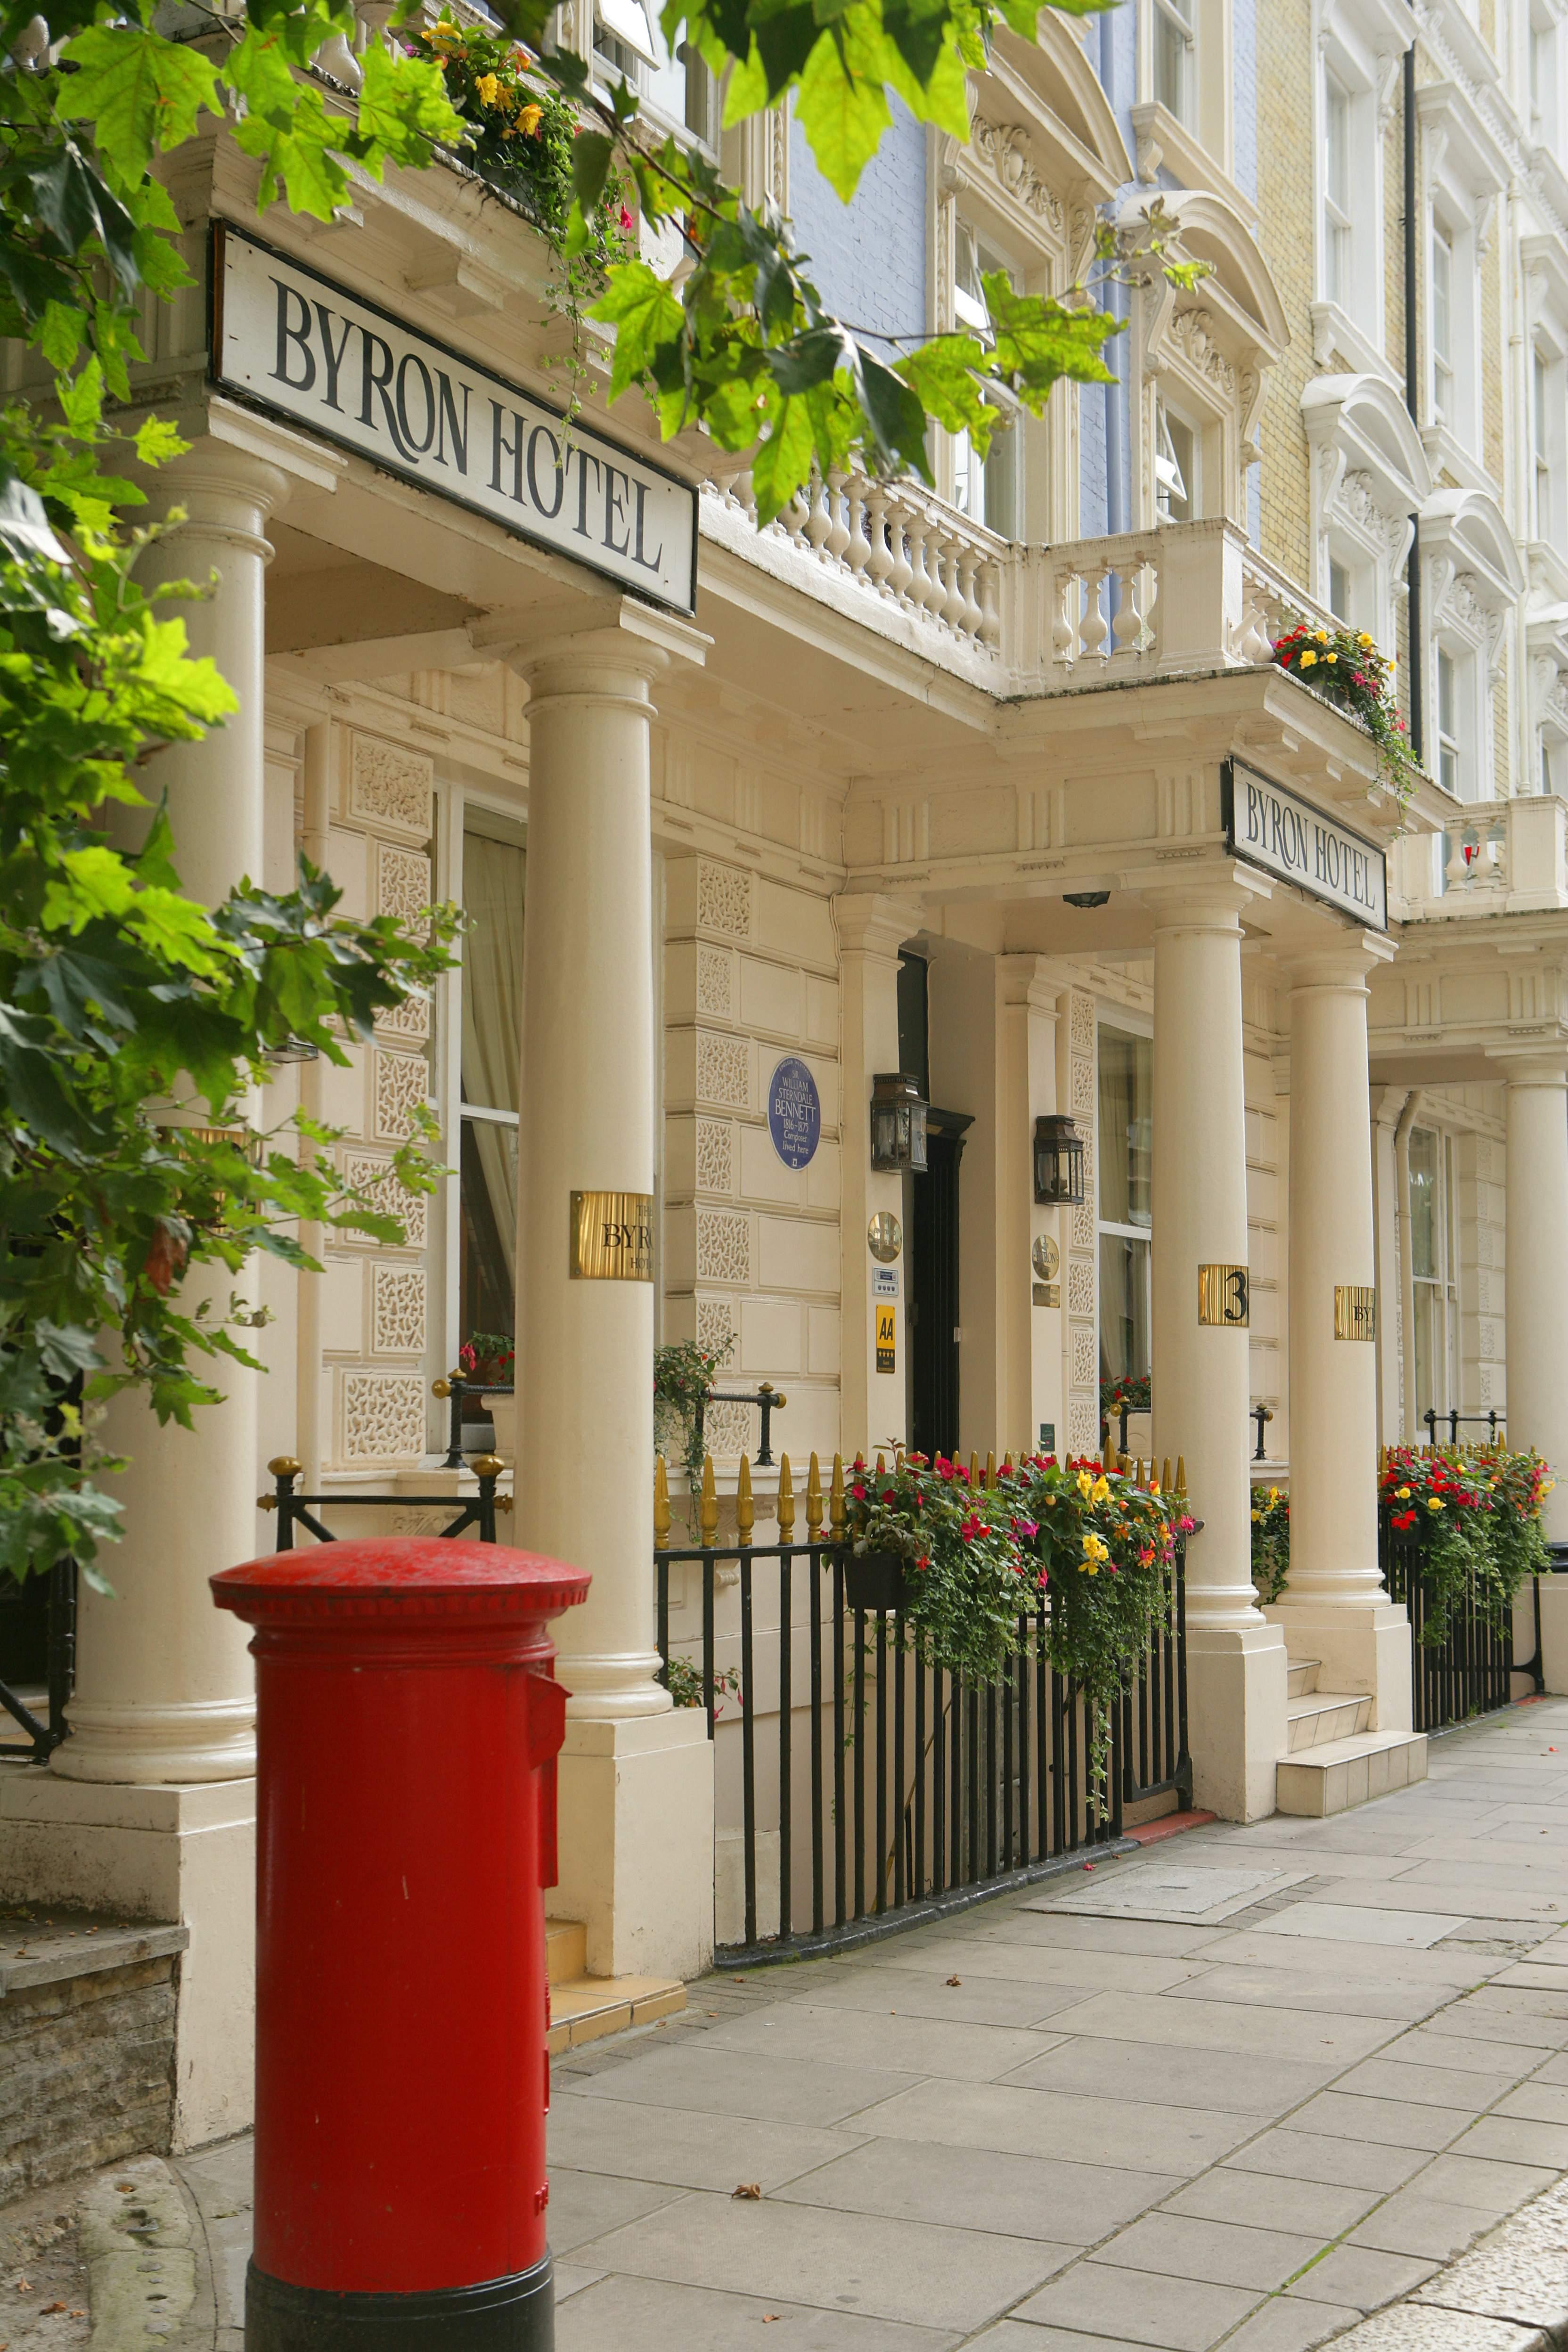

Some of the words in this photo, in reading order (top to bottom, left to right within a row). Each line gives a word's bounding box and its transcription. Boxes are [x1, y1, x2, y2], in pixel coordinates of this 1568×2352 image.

[267, 275, 473, 476] BYRON
[487, 398, 663, 573] HOTEL
[1246, 782, 1309, 873] BYRON
[1314, 823, 1375, 910] HOTEL
[778, 1087, 813, 1105] STERNDALE
[782, 1077, 808, 1093] WILLIAM
[775, 1098, 817, 1122] BENNETT
[783, 1141, 796, 1152] lived
[797, 1143, 809, 1154] here
[784, 1130, 808, 1143] Composer
[1225, 1271, 1247, 1320] 3
[879, 1317, 893, 1341] AA
